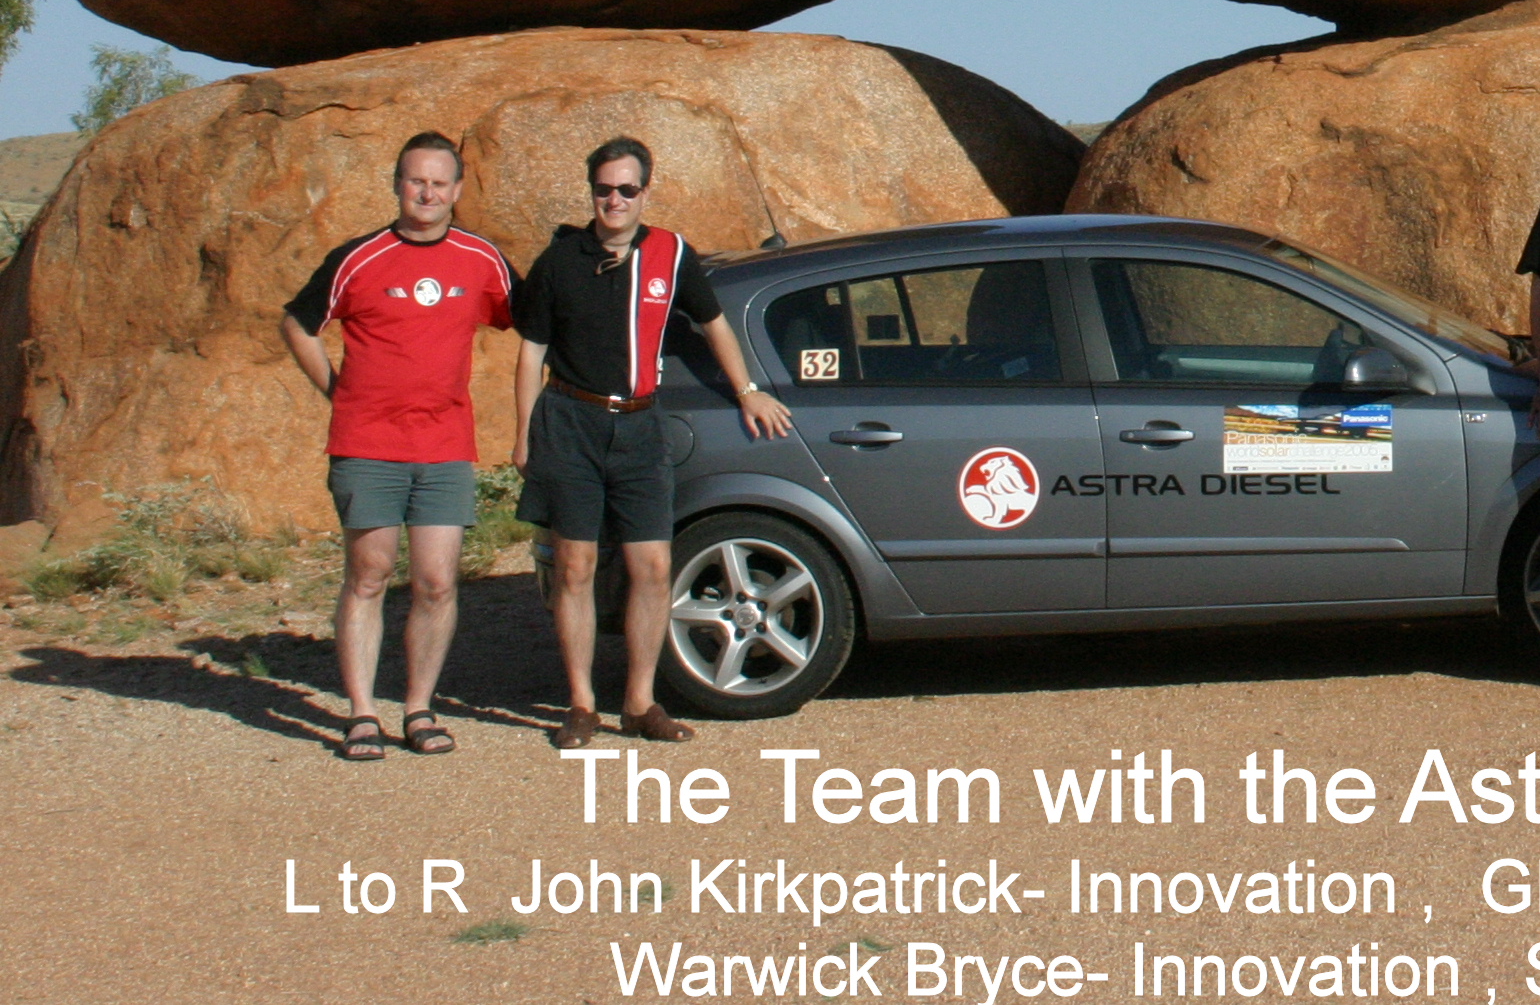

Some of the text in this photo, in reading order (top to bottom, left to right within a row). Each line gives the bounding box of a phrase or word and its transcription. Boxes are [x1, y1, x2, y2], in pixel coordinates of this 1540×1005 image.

[803, 351, 837, 377] 32
[1343, 414, 1389, 424] Panasonic
[1226, 431, 1308, 444] Panasonic
[1050, 473, 1341, 496] ASTRA DIESEL
